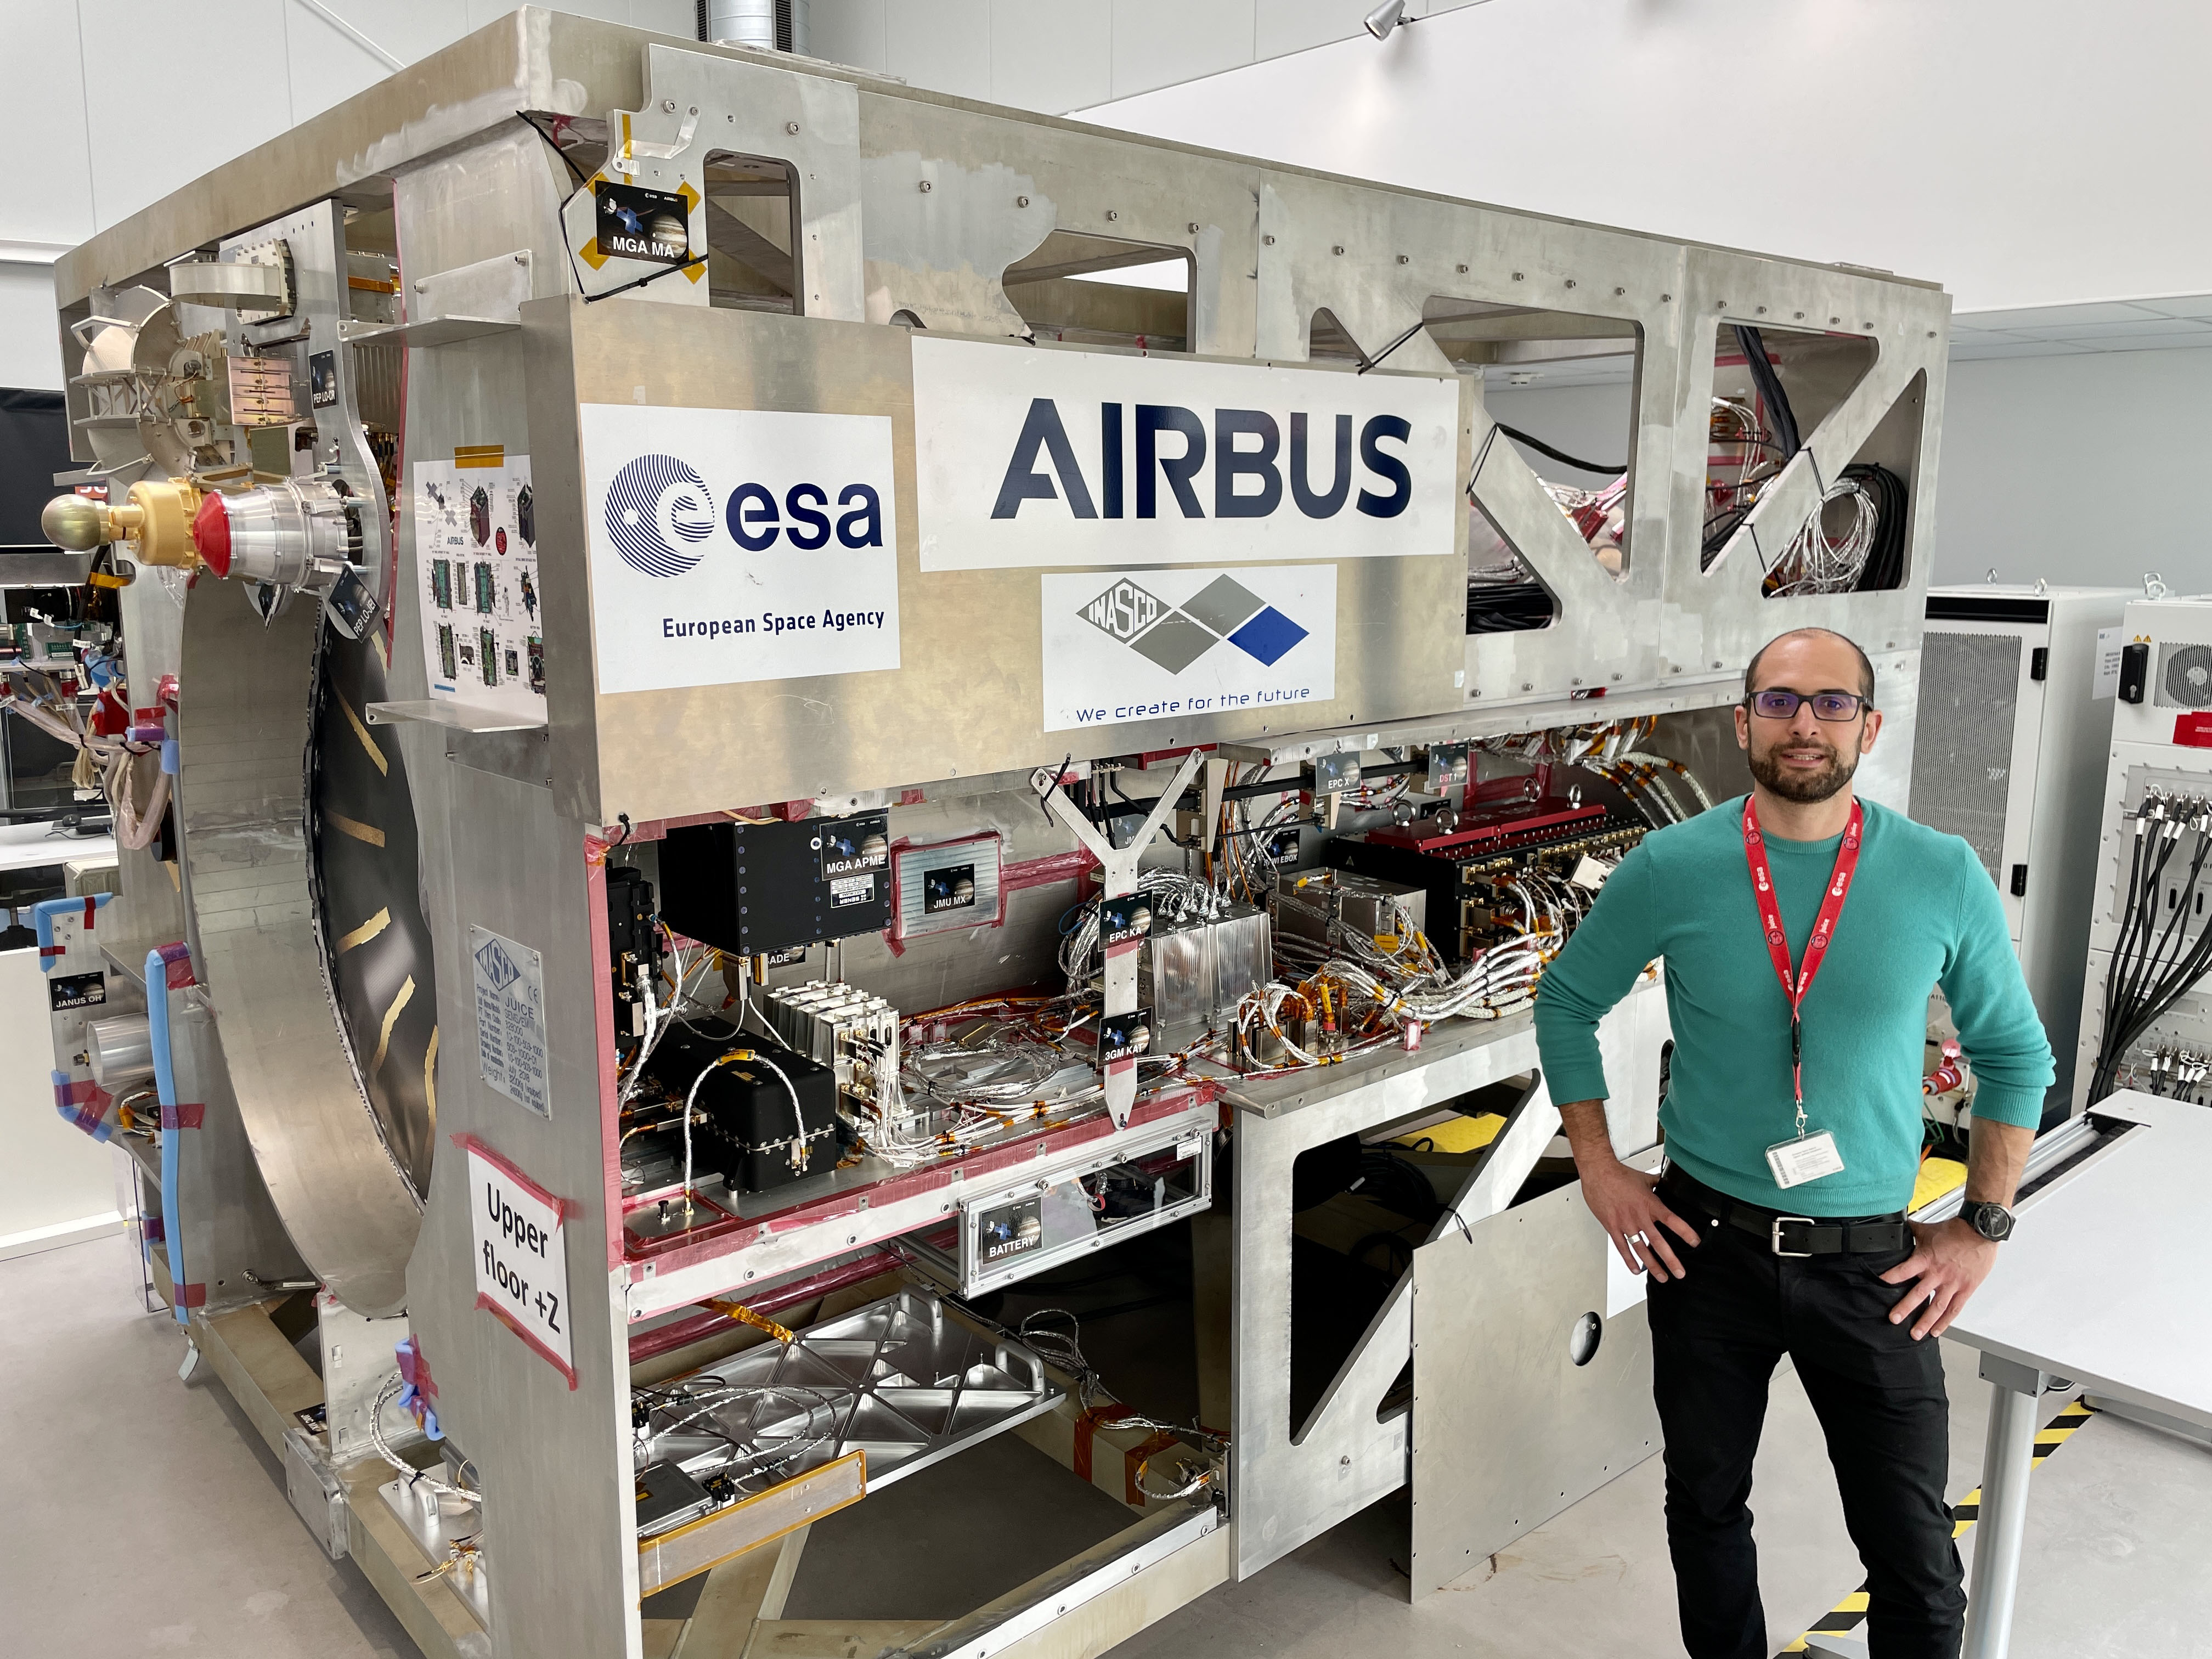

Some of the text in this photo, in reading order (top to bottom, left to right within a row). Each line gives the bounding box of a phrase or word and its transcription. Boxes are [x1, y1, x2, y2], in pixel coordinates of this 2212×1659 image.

[613, 236, 675, 258] MGA MA
[313, 392, 321, 404] PEP
[990, 398, 1412, 519] AIRBUS
[726, 482, 883, 551] esa
[447, 537, 464, 545] AIRBUS
[1088, 582, 1158, 639] INASCO
[353, 619, 363, 636] PEP
[663, 609, 884, 640] European Space Agency
[1076, 687, 1310, 722] We create for the future
[1328, 777, 1350, 789] EPC X
[1440, 773, 1457, 782] DST 1
[1125, 836, 1135, 845] JM
[827, 854, 885, 874] MGA APME
[1280, 854, 1297, 864] EBOX
[1757, 866, 1765, 882] esa
[1836, 872, 1847, 888] esa
[839, 896, 859, 905] SENER
[934, 895, 966, 909] JMU MX
[1109, 926, 1142, 943] EPC KA
[479, 939, 515, 986] INASCO
[1800, 972, 1809, 985] esa
[56, 995, 101, 1008] JANUS OH
[505, 996, 534, 1019] JUICE
[1105, 1042, 1143, 1061] 3GM KAT
[482, 1062, 505, 1085] Weight:
[487, 1182, 548, 1259] Upper
[989, 1234, 1035, 1257] BATTERY
[483, 1239, 560, 1334] floor +Z
